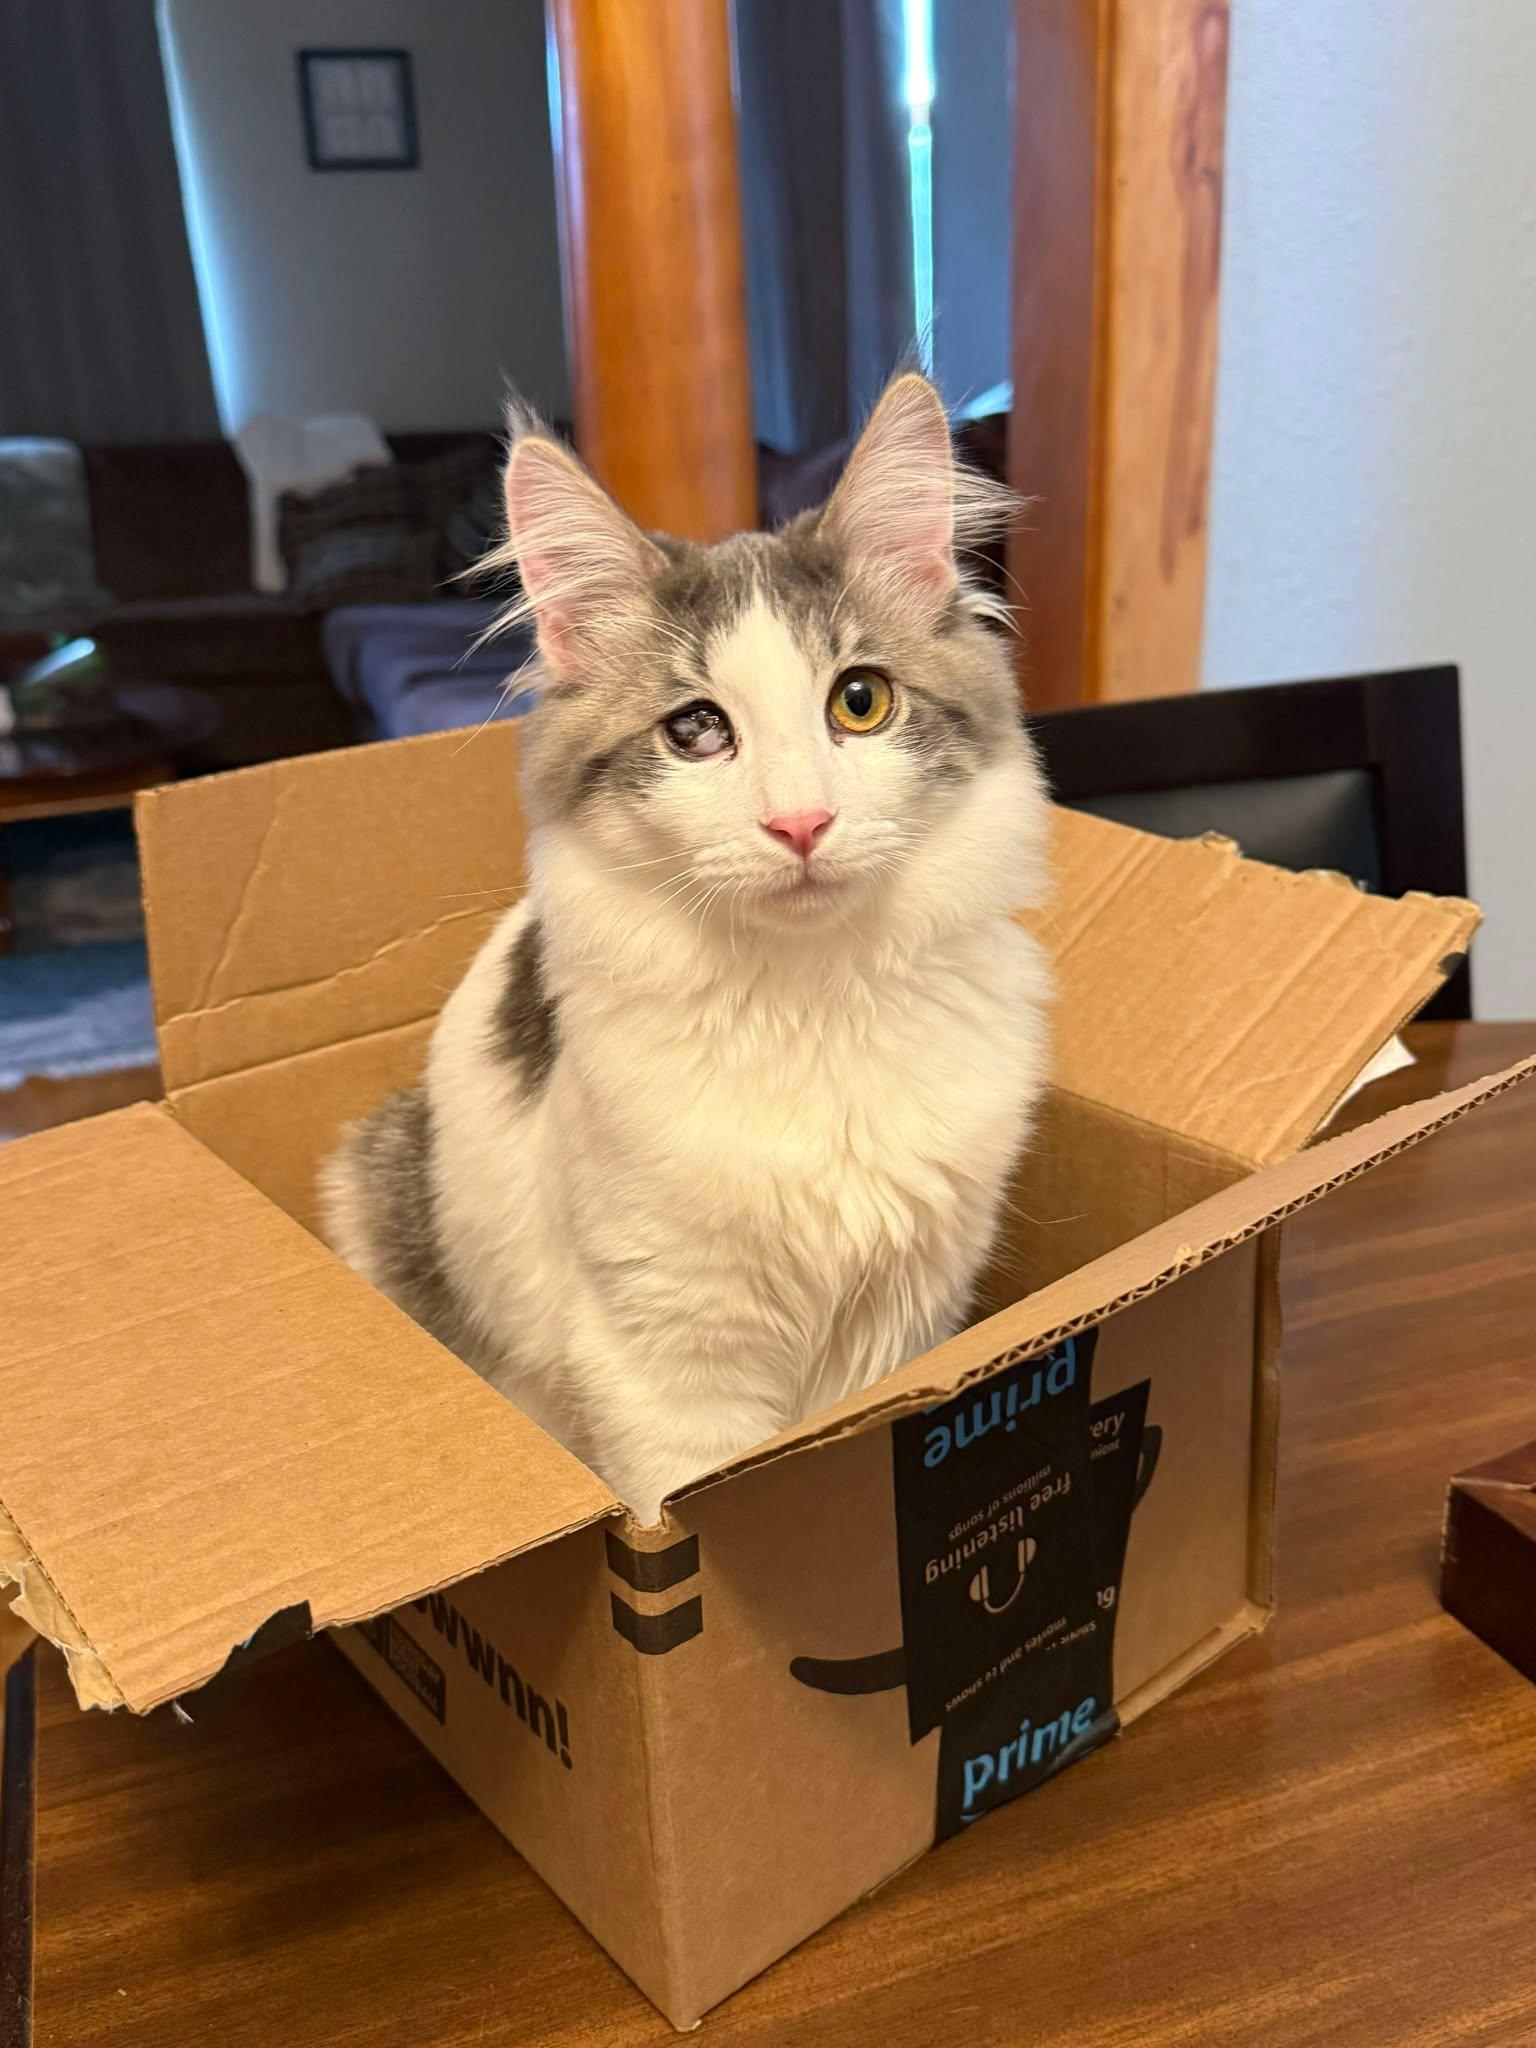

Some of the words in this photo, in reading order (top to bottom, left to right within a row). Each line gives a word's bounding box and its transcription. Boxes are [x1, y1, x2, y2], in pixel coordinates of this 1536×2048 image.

[924, 1337, 1077, 1468] prime
[1089, 1411, 1126, 1438] ery
[1002, 1464, 1051, 1503] millions
[1029, 1471, 1072, 1511] free
[948, 1510, 985, 1541] songs
[987, 1499, 1001, 1518] of
[925, 1505, 1024, 1585] listening
[1000, 1647, 1023, 1672] and
[413, 1592, 574, 1770] wwnn!
[945, 1678, 983, 1712] shows
[962, 1696, 1096, 1809] prime
